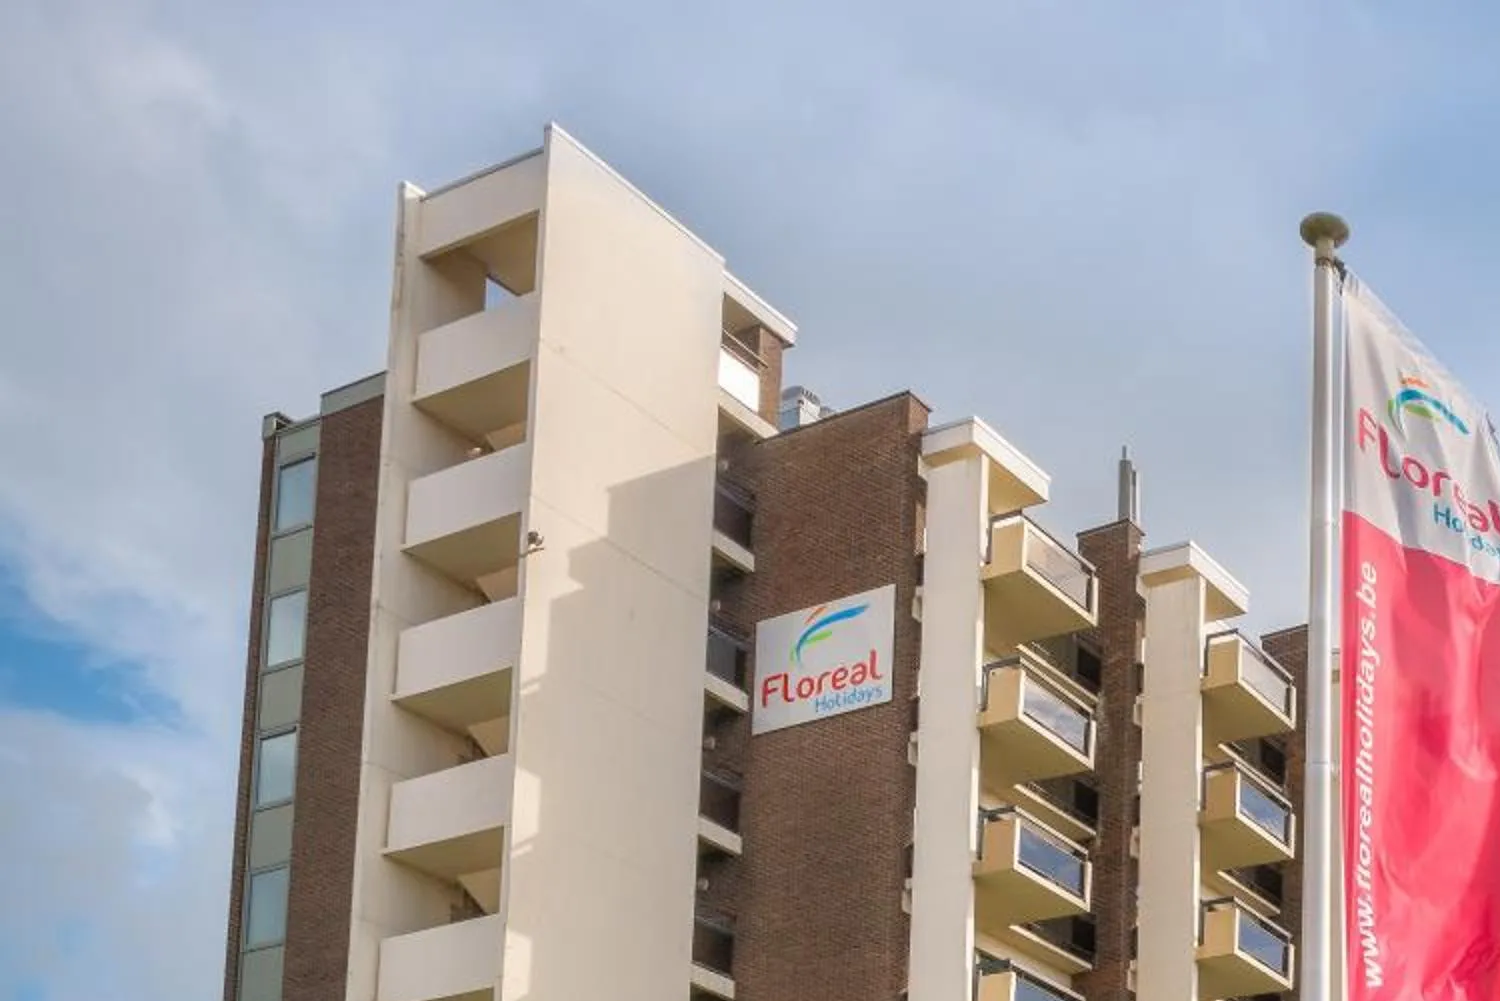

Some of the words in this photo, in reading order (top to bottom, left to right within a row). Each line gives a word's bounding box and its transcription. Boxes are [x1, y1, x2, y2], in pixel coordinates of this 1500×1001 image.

[761, 650, 883, 707] Floreal
[815, 685, 883, 713] Holidays
[1355, 561, 1384, 989] www.florealholidays.be
